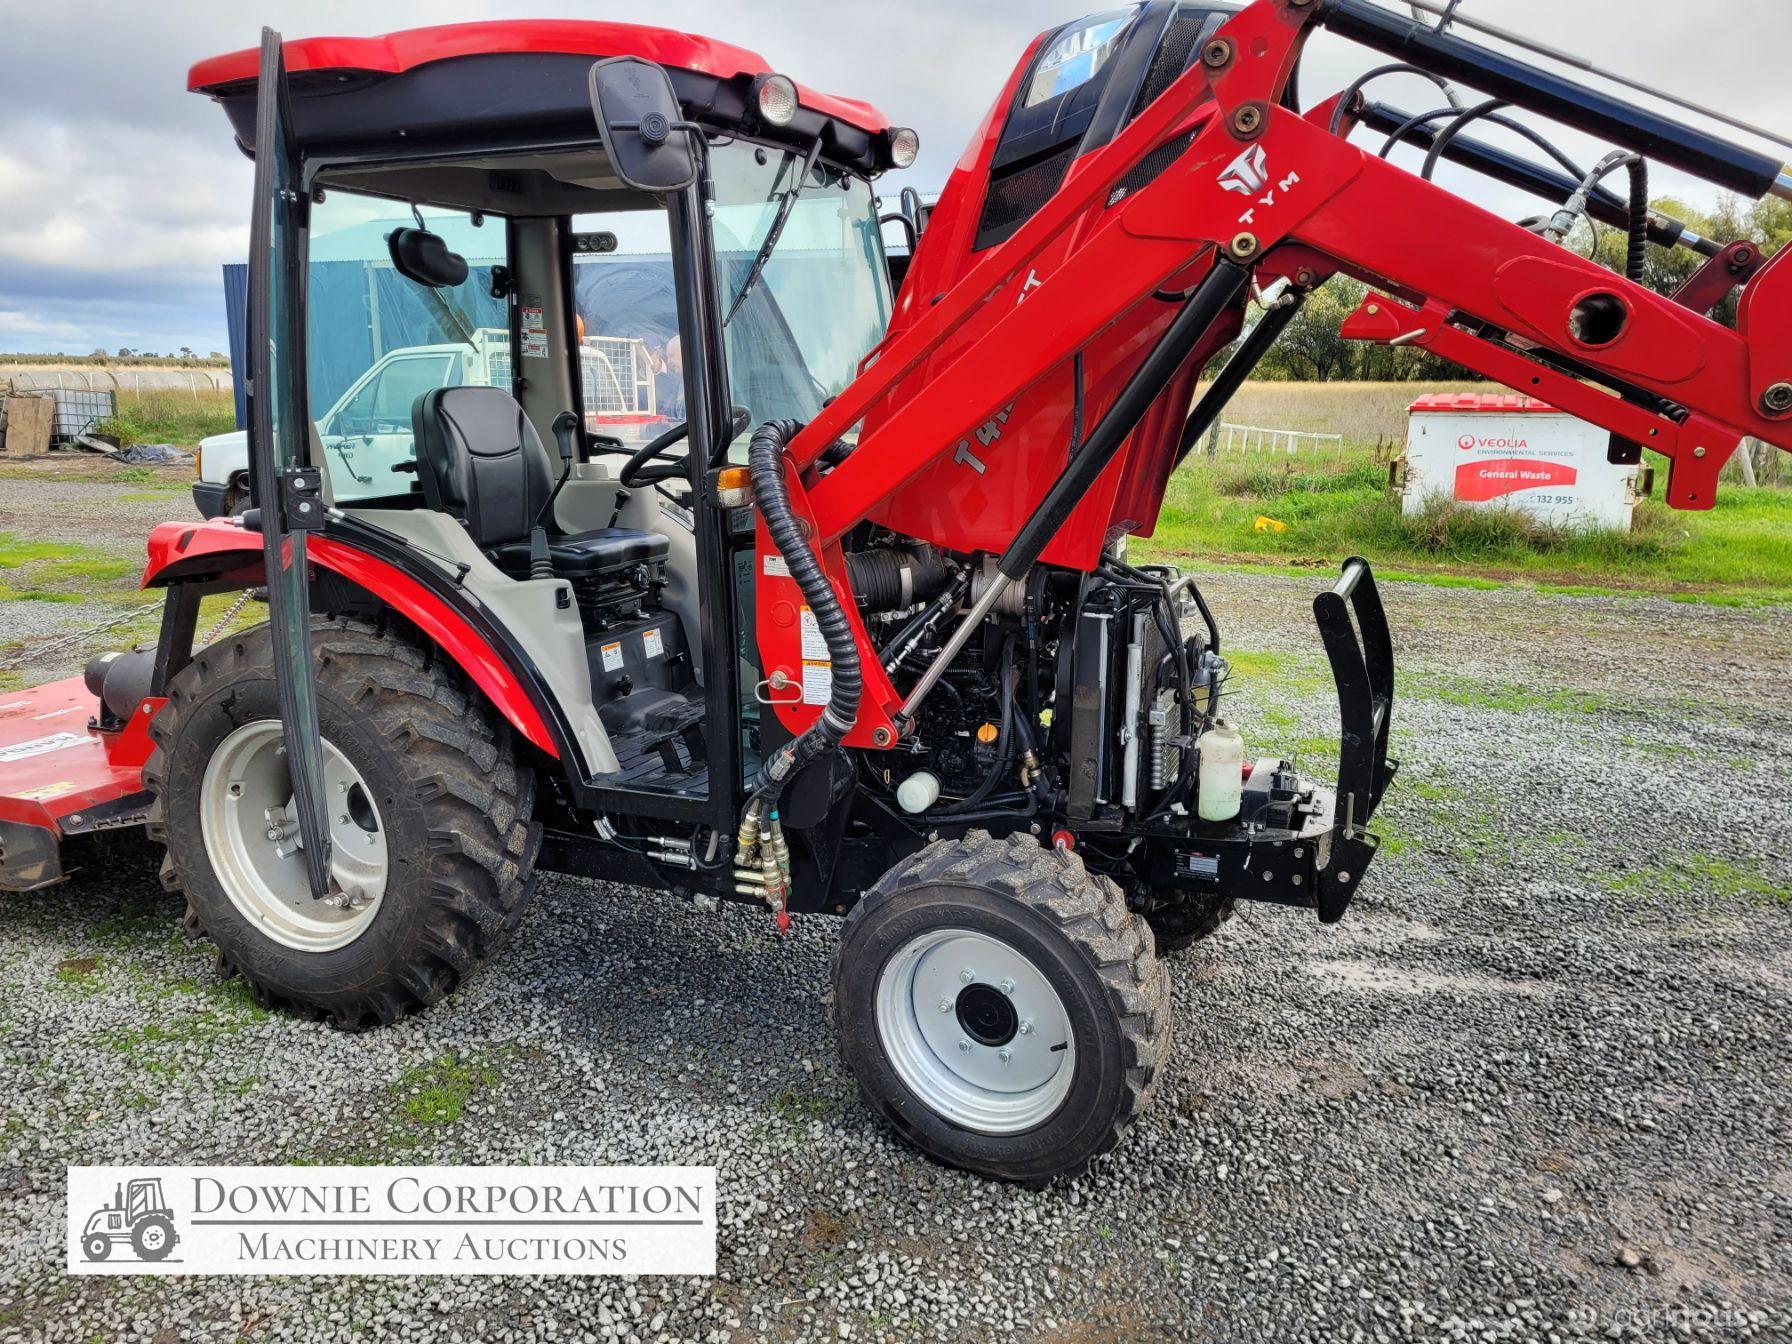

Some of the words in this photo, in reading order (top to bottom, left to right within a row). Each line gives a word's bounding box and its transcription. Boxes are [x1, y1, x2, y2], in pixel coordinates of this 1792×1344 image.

[1238, 170, 1300, 225] TYM
[1477, 438, 1528, 448] VEOLIA
[1479, 469, 1518, 479] General
[1519, 470, 1552, 480] Waste
[1536, 495, 1553, 504] 132
[1555, 495, 1574, 505] 955
